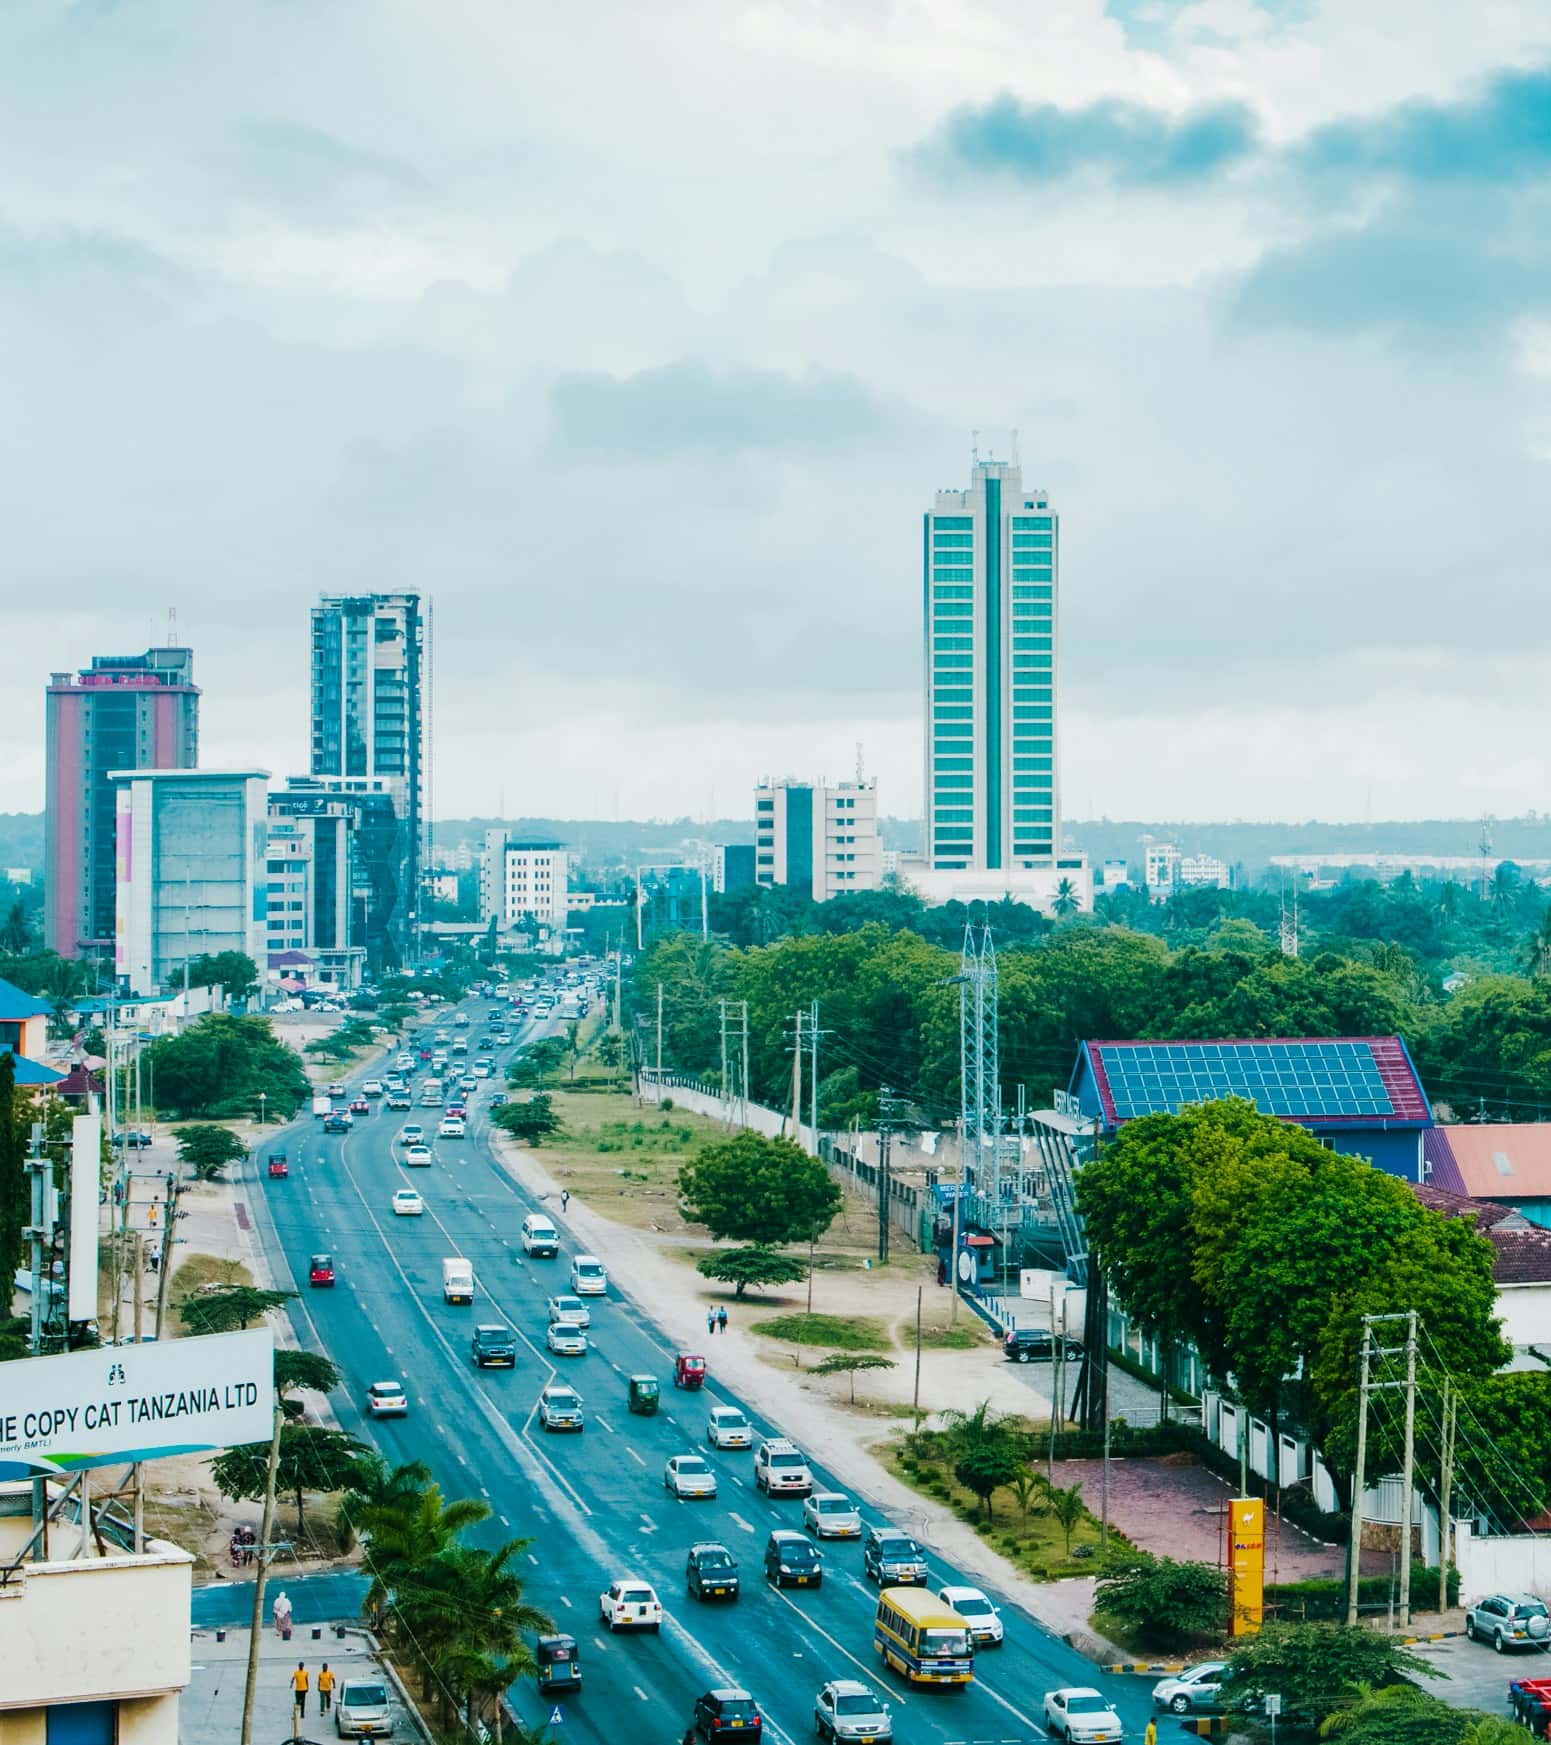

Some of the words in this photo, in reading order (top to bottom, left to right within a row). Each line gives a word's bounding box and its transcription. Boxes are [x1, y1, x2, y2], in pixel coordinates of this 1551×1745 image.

[24, 1407, 79, 1439] COPY
[84, 1401, 121, 1430] CAT
[127, 1387, 221, 1423] TANZANIA
[225, 1382, 258, 1409] LTD
